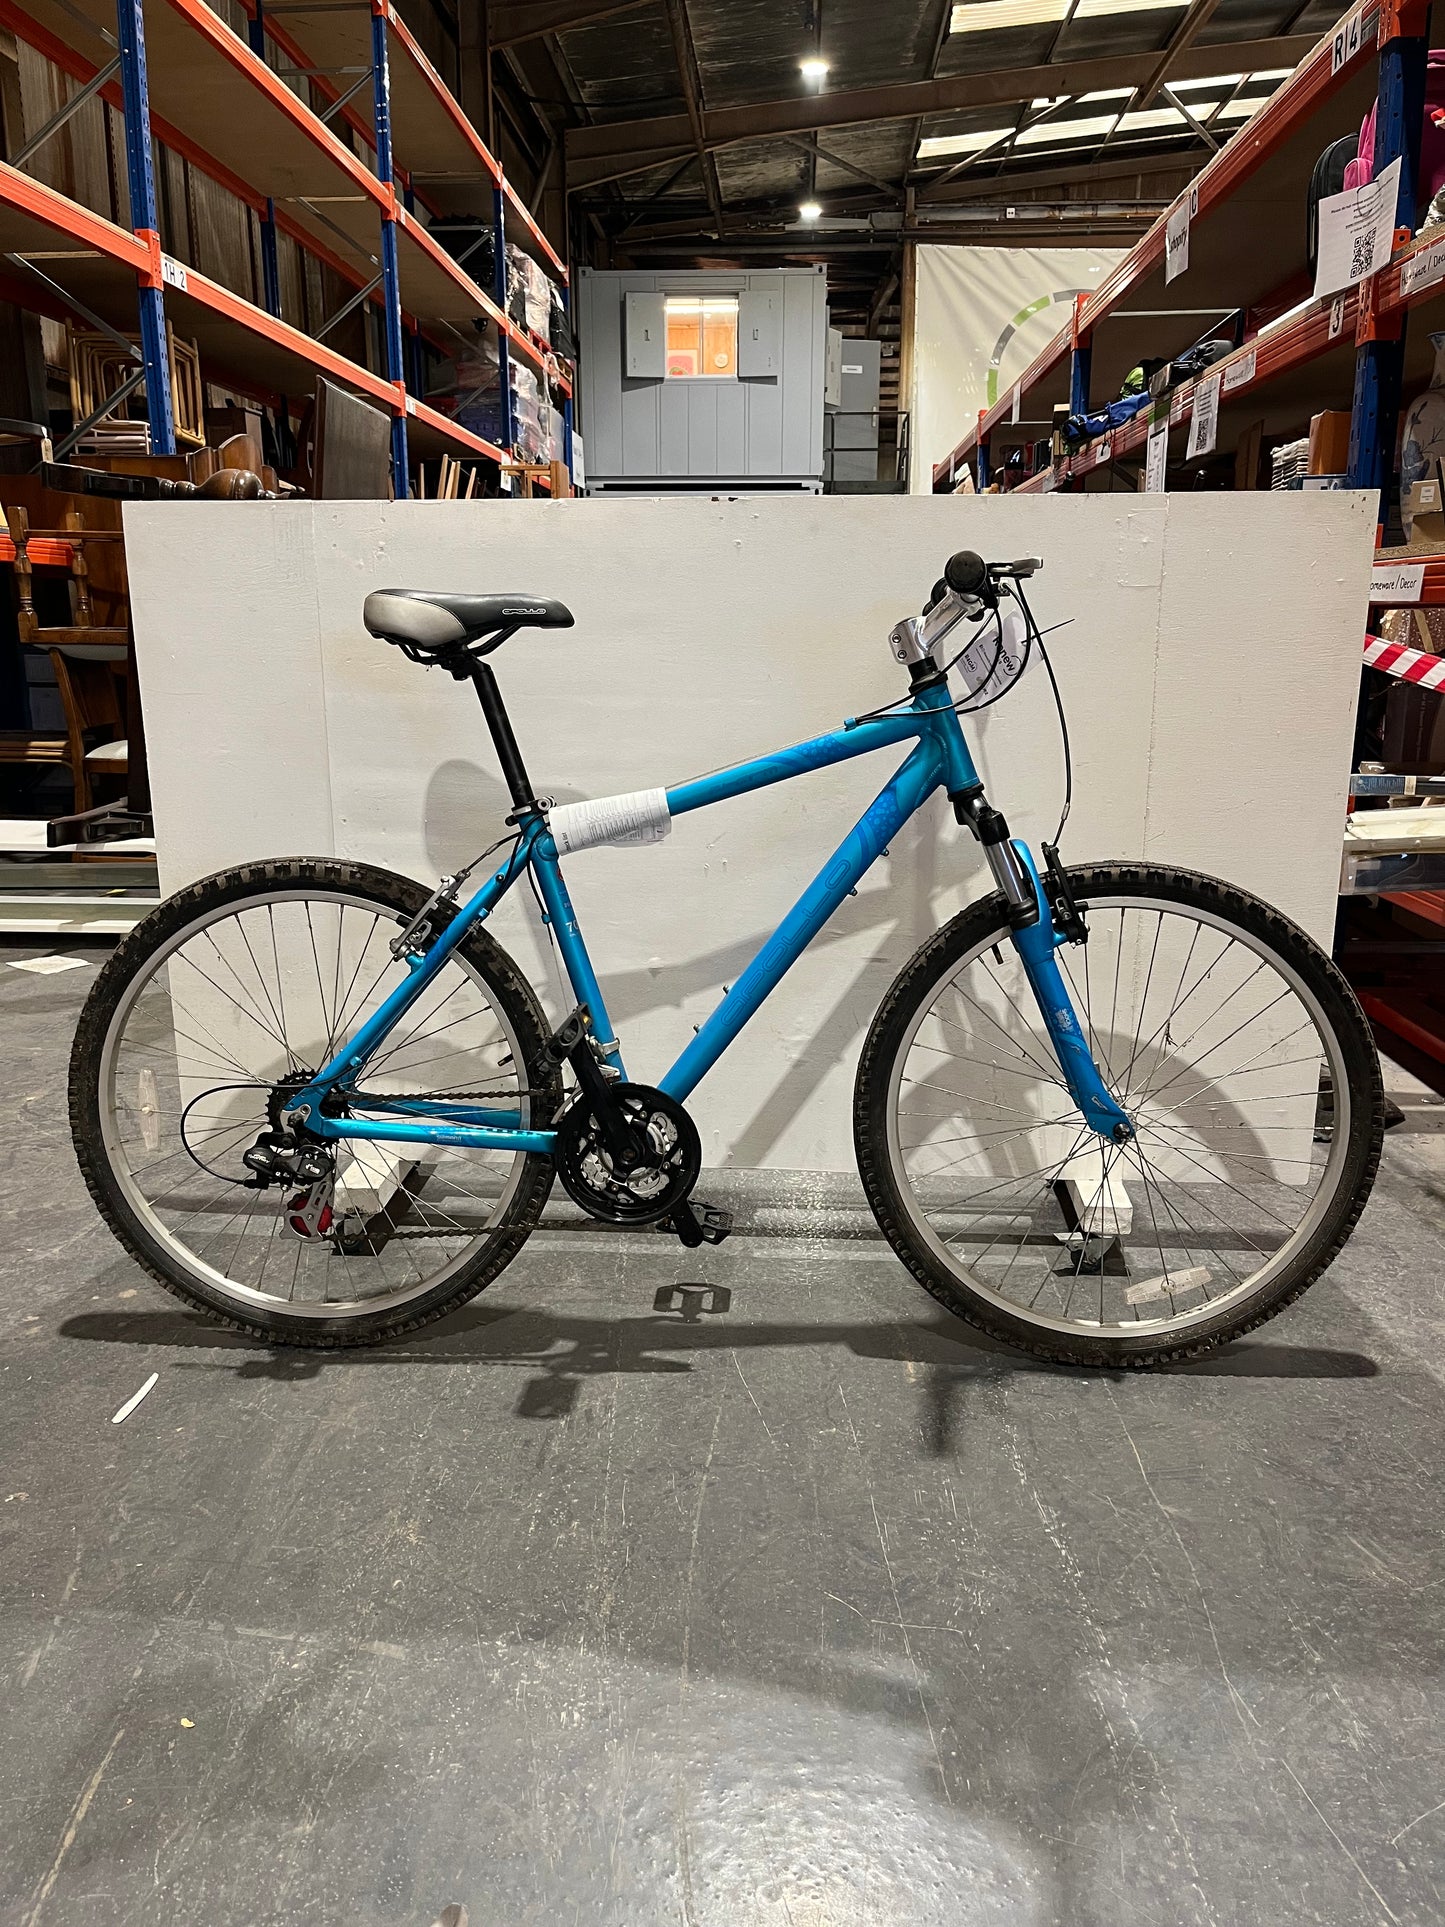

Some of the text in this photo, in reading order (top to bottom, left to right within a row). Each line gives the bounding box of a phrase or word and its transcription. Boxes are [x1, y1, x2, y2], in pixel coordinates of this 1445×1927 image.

[1334, 32, 1344, 70] R
[1191, 188, 1198, 215] C
[1332, 299, 1342, 334] 3
[992, 635, 1016, 672] Rnew
